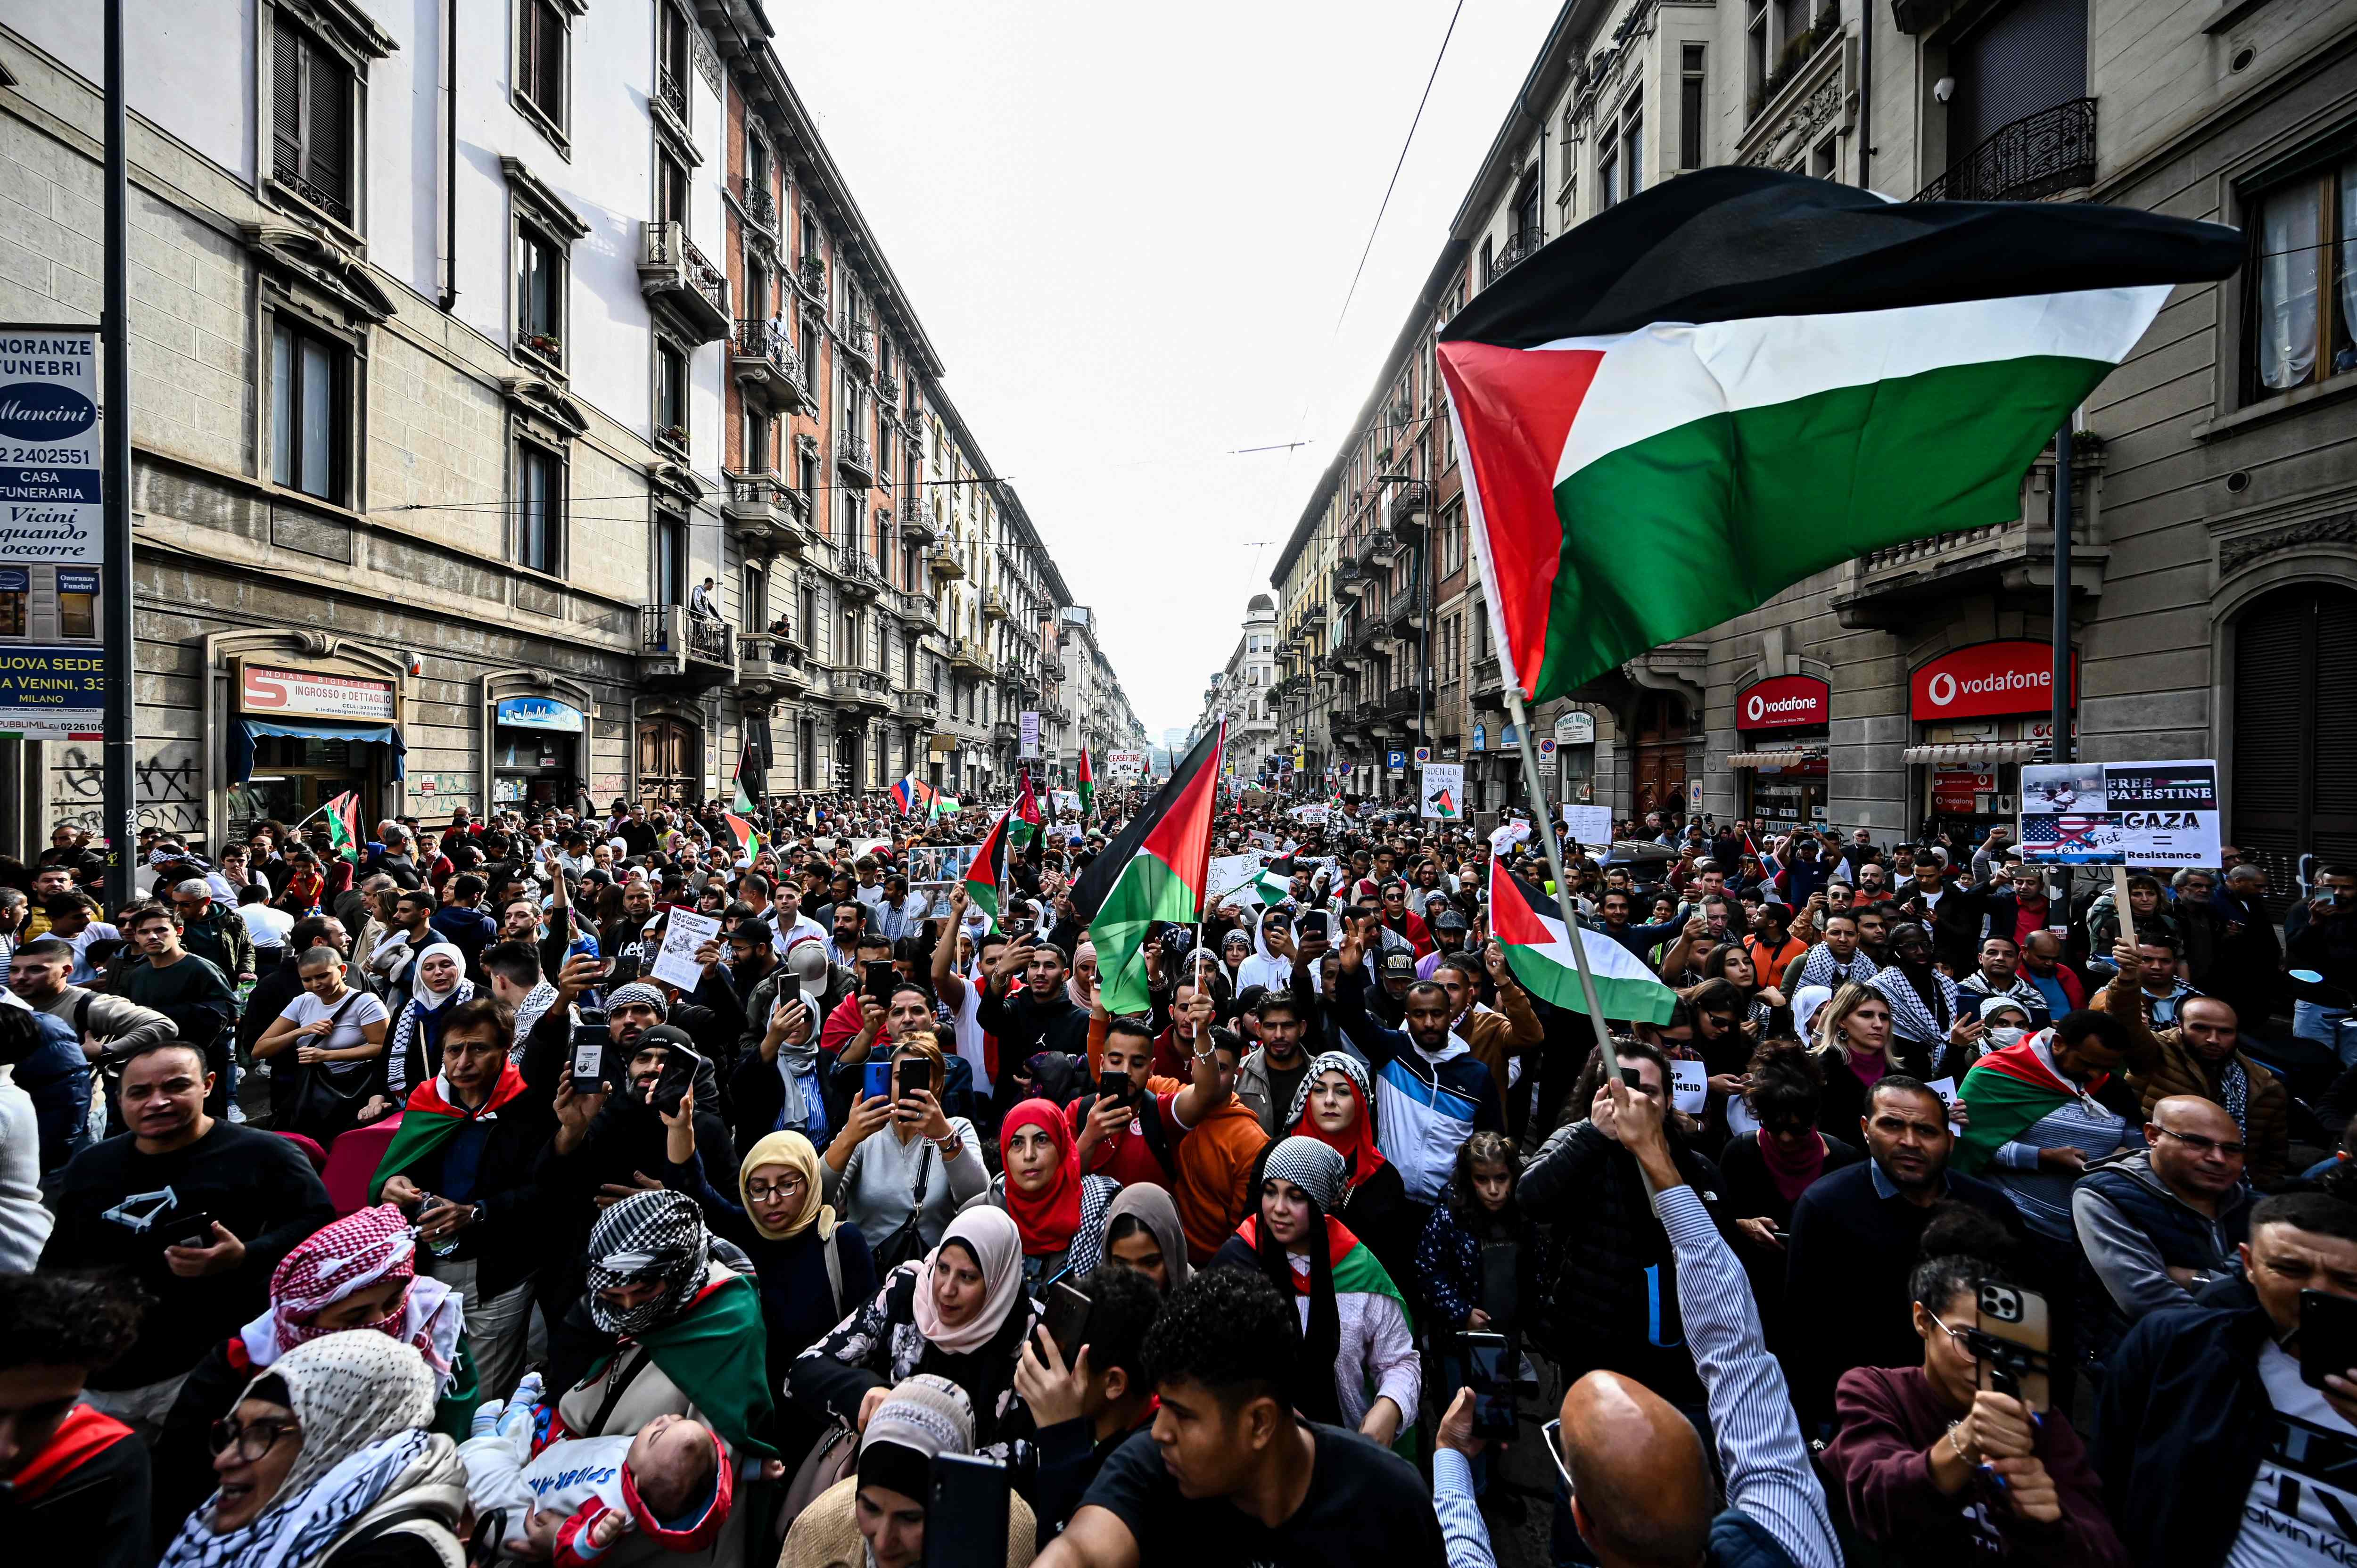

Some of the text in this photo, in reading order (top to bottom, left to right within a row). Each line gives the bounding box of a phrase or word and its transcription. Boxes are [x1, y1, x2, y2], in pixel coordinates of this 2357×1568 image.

[0, 400, 88, 422] Mancini
[13, 448, 89, 464] 2402551
[20, 472, 59, 483] CASA
[0, 486, 84, 499] FUNERARIA
[9, 507, 78, 523] Vicini
[0, 524, 88, 542] quando
[1, 545, 85, 556] occorre
[53, 658, 104, 671] SEDE
[261, 670, 386, 690] INDIAN BIGIOTTERIA
[1961, 671, 2051, 694] vodafone
[19, 695, 64, 703] MILANO
[295, 686, 339, 698] INGROSSO
[349, 691, 391, 704] DETTAGLIO
[1766, 697, 1816, 712] vodafone
[1391, 754, 1401, 765] P
[1426, 767, 1444, 775] BIDEN
[2107, 778, 2153, 788] FREE
[2108, 788, 2212, 800] PALESTINE
[2124, 812, 2201, 830] GAZA
[2053, 832, 2121, 856] terrorist
[1207, 880, 1220, 888] TO
[672, 910, 681, 920] NO
[1388, 956, 1412, 969] NAVY
[528, 1465, 616, 1497] SPIDER-MA
